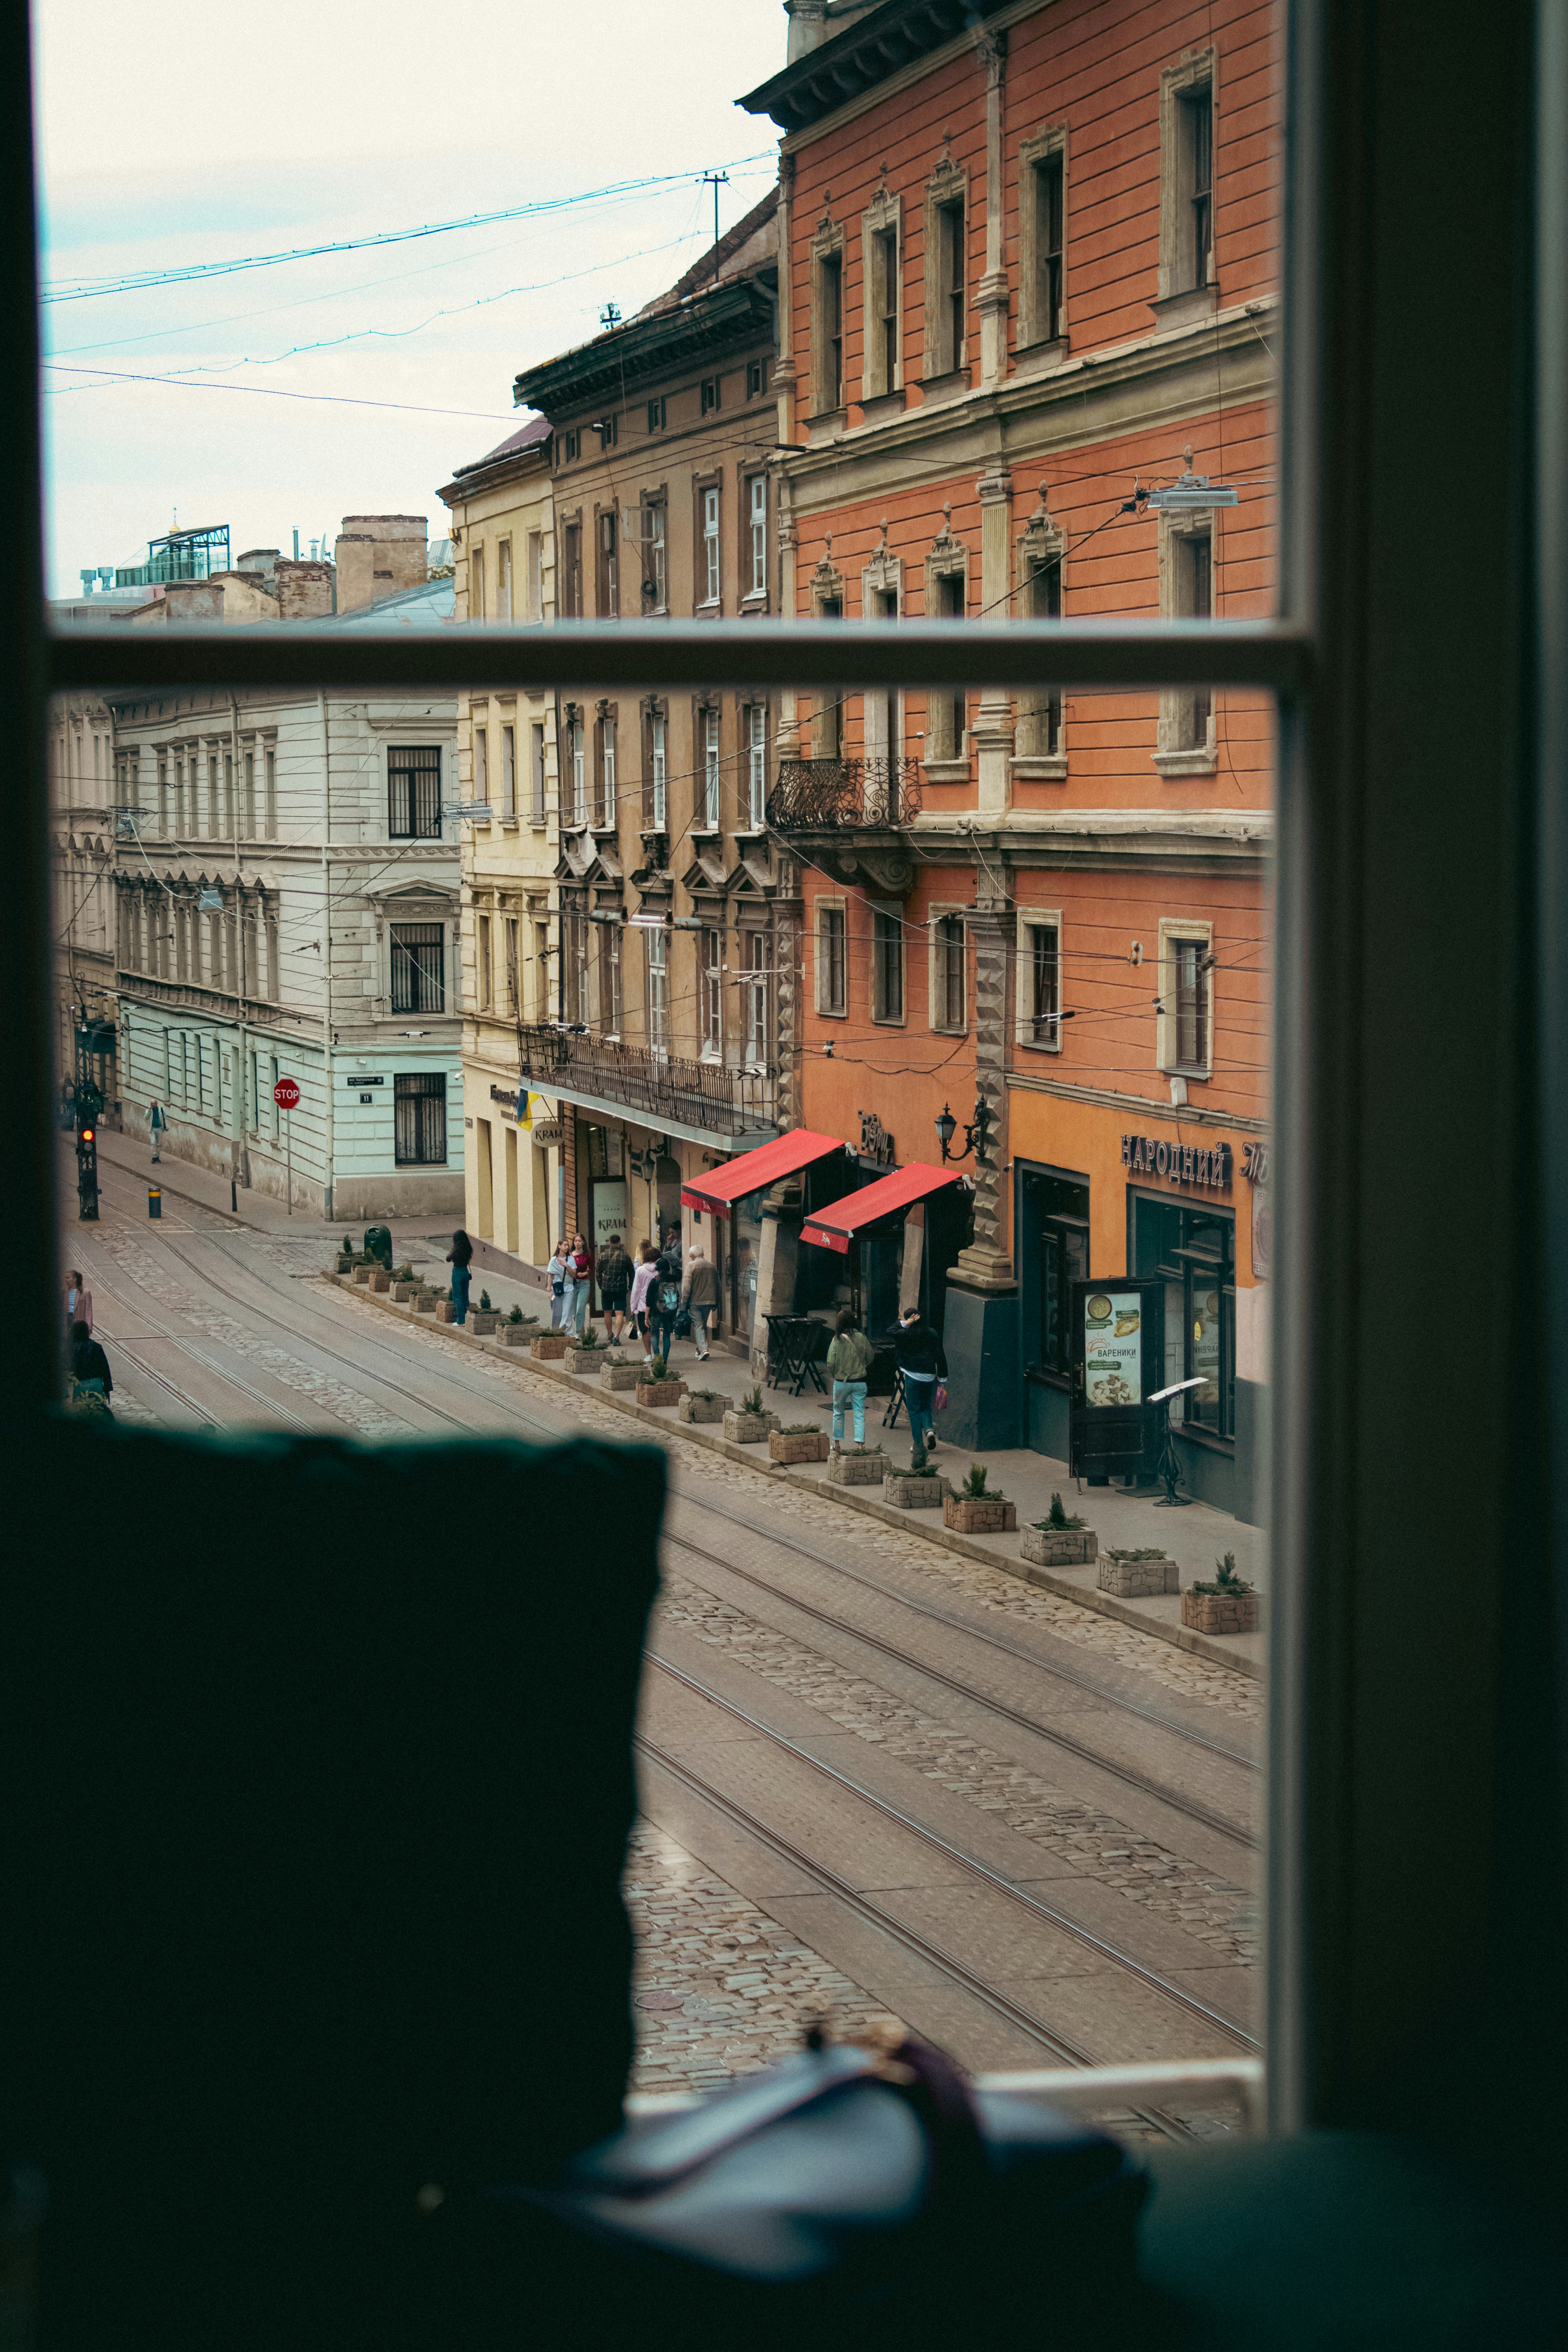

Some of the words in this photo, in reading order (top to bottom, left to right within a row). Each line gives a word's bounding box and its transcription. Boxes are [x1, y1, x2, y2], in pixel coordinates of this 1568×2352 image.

[275, 1089, 299, 1099] STOP
[535, 1129, 562, 1141] KRAM
[1120, 1134, 1224, 1187] НАРОДНИЙ
[598, 1219, 627, 1231] KRAM
[1098, 1349, 1136, 1357] ВАРЕНИКИ
